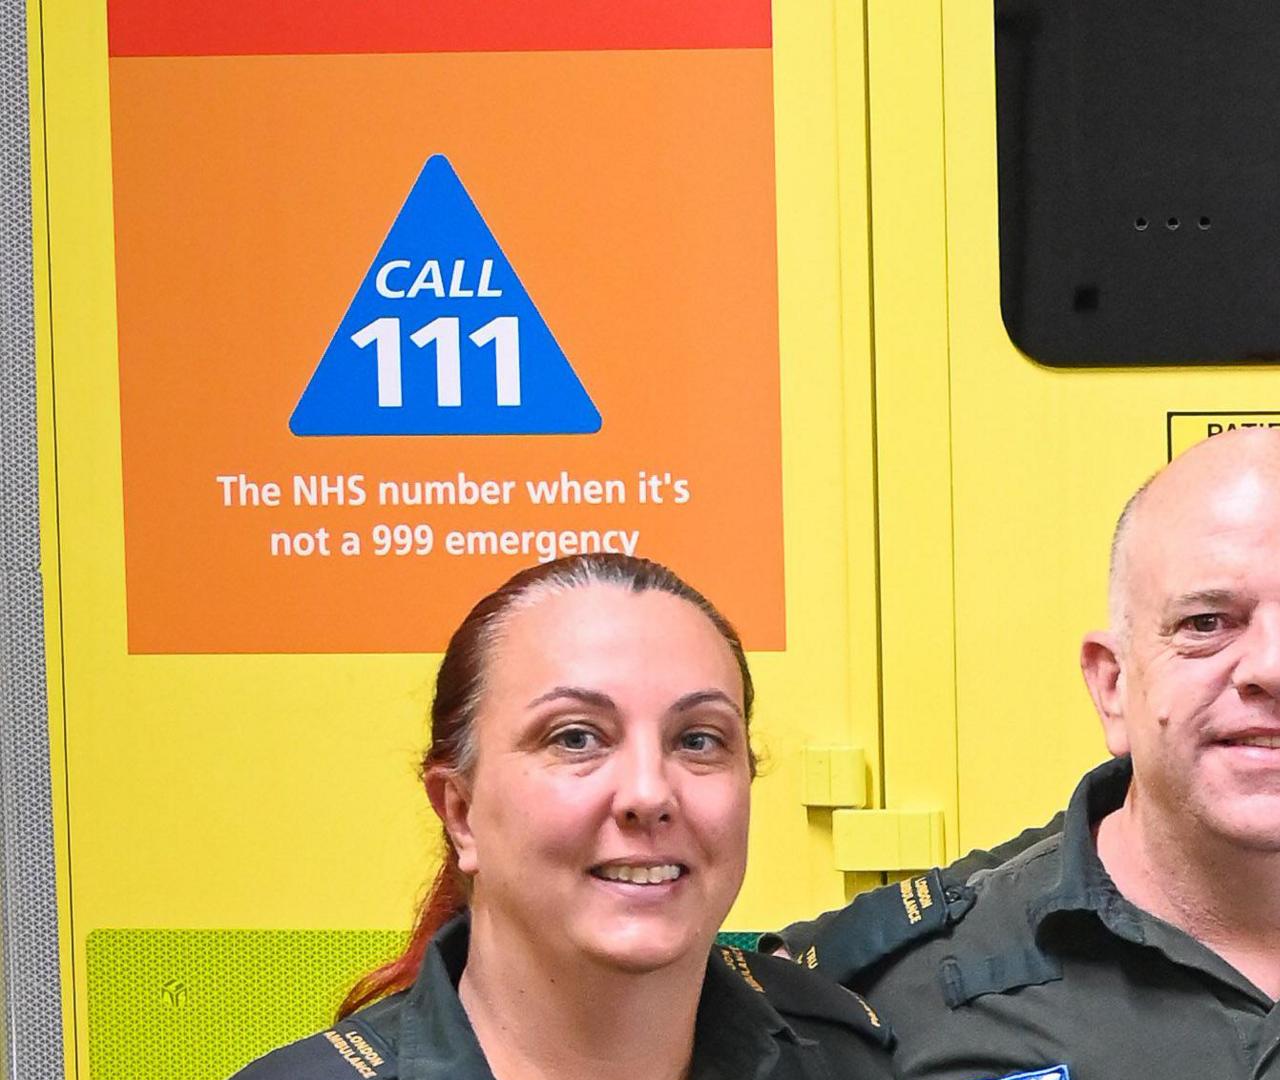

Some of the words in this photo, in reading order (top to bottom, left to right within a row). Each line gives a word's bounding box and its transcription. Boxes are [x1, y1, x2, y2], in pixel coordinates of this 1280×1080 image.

[375, 259, 503, 299] CALL
[350, 316, 521, 408] 111
[217, 475, 281, 506] The
[293, 474, 366, 507] NHS
[380, 472, 516, 505] number
[526, 472, 626, 504] when
[638, 471, 690, 503] it's
[271, 528, 328, 556] not
[341, 535, 361, 556] a
[372, 524, 433, 556] 999
[445, 529, 640, 563] emergency
[323, 1029, 377, 1080] AMBULANCE
[345, 1030, 385, 1068] LONDON
